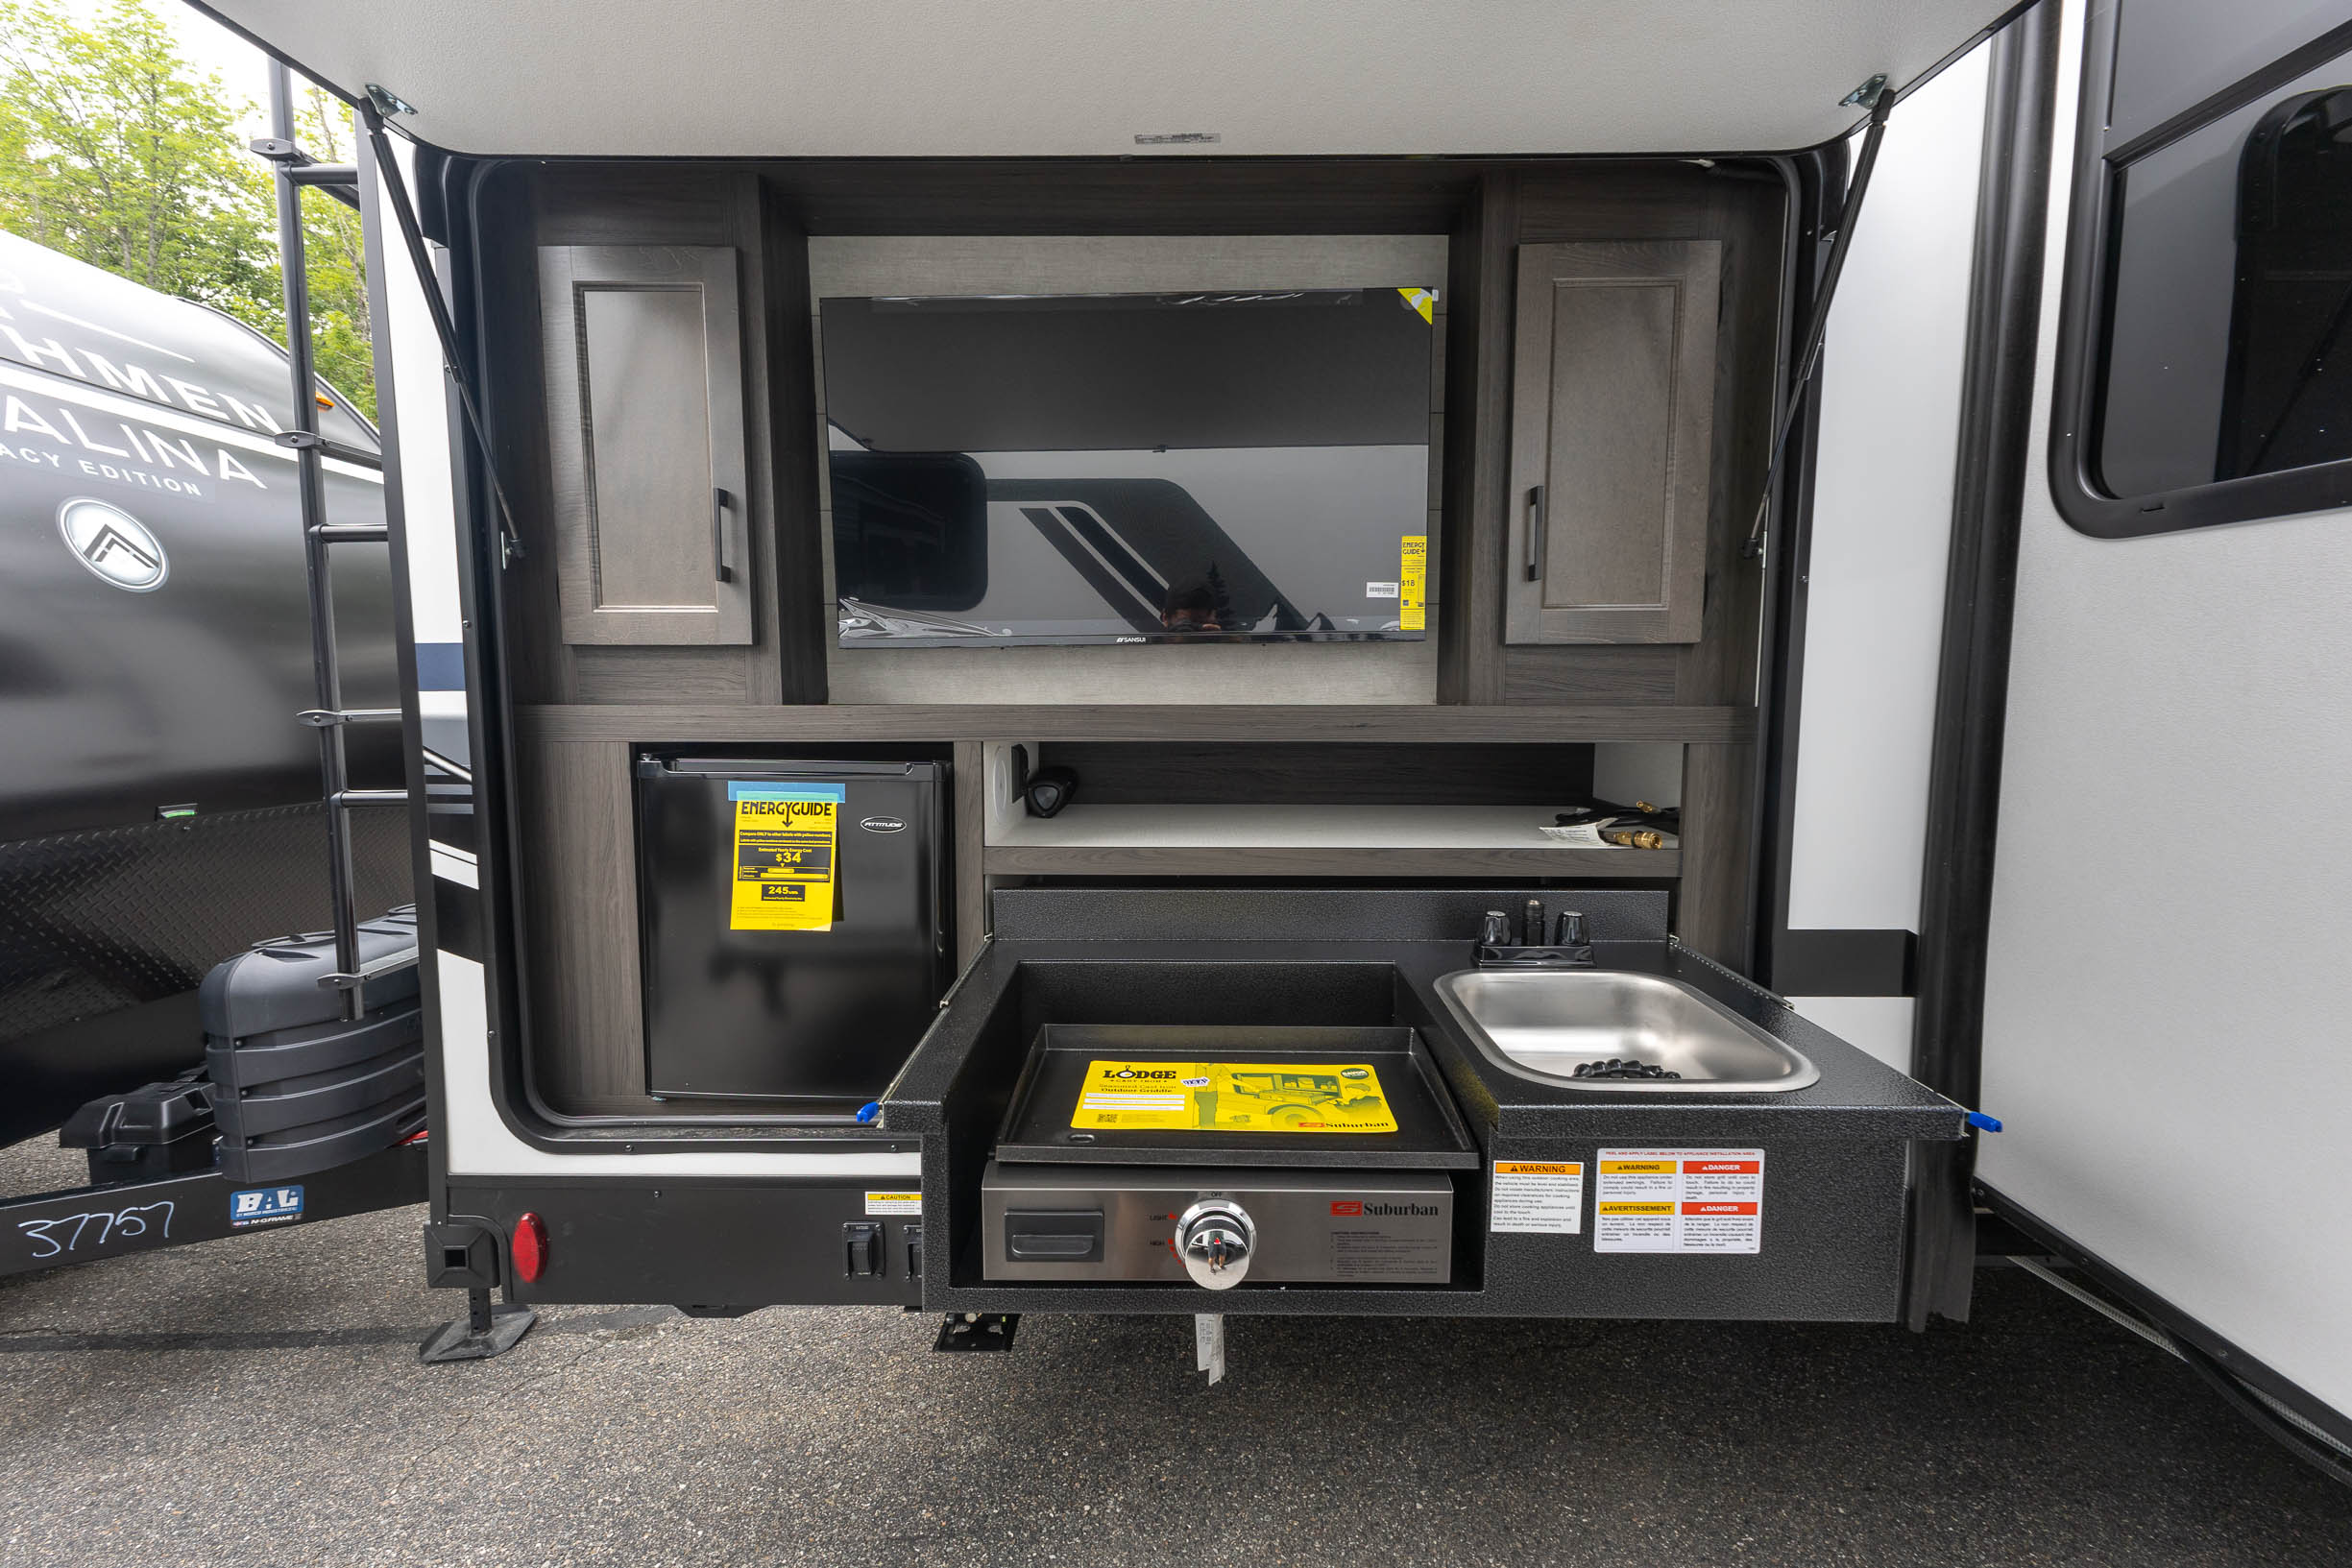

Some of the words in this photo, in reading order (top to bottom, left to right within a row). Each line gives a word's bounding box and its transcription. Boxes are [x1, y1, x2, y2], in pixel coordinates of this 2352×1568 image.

[4, 395, 268, 490] ALINA
[78, 459, 202, 496] EDITION
[741, 801, 832, 816] ENERGYGUIDE
[776, 852, 801, 863] $34
[769, 886, 789, 894] 245
[1103, 1069, 1176, 1079] LODGE
[237, 1190, 299, 1213] BAL
[1364, 1203, 1438, 1216] Suburban
[18, 1200, 174, 1258] 37757
